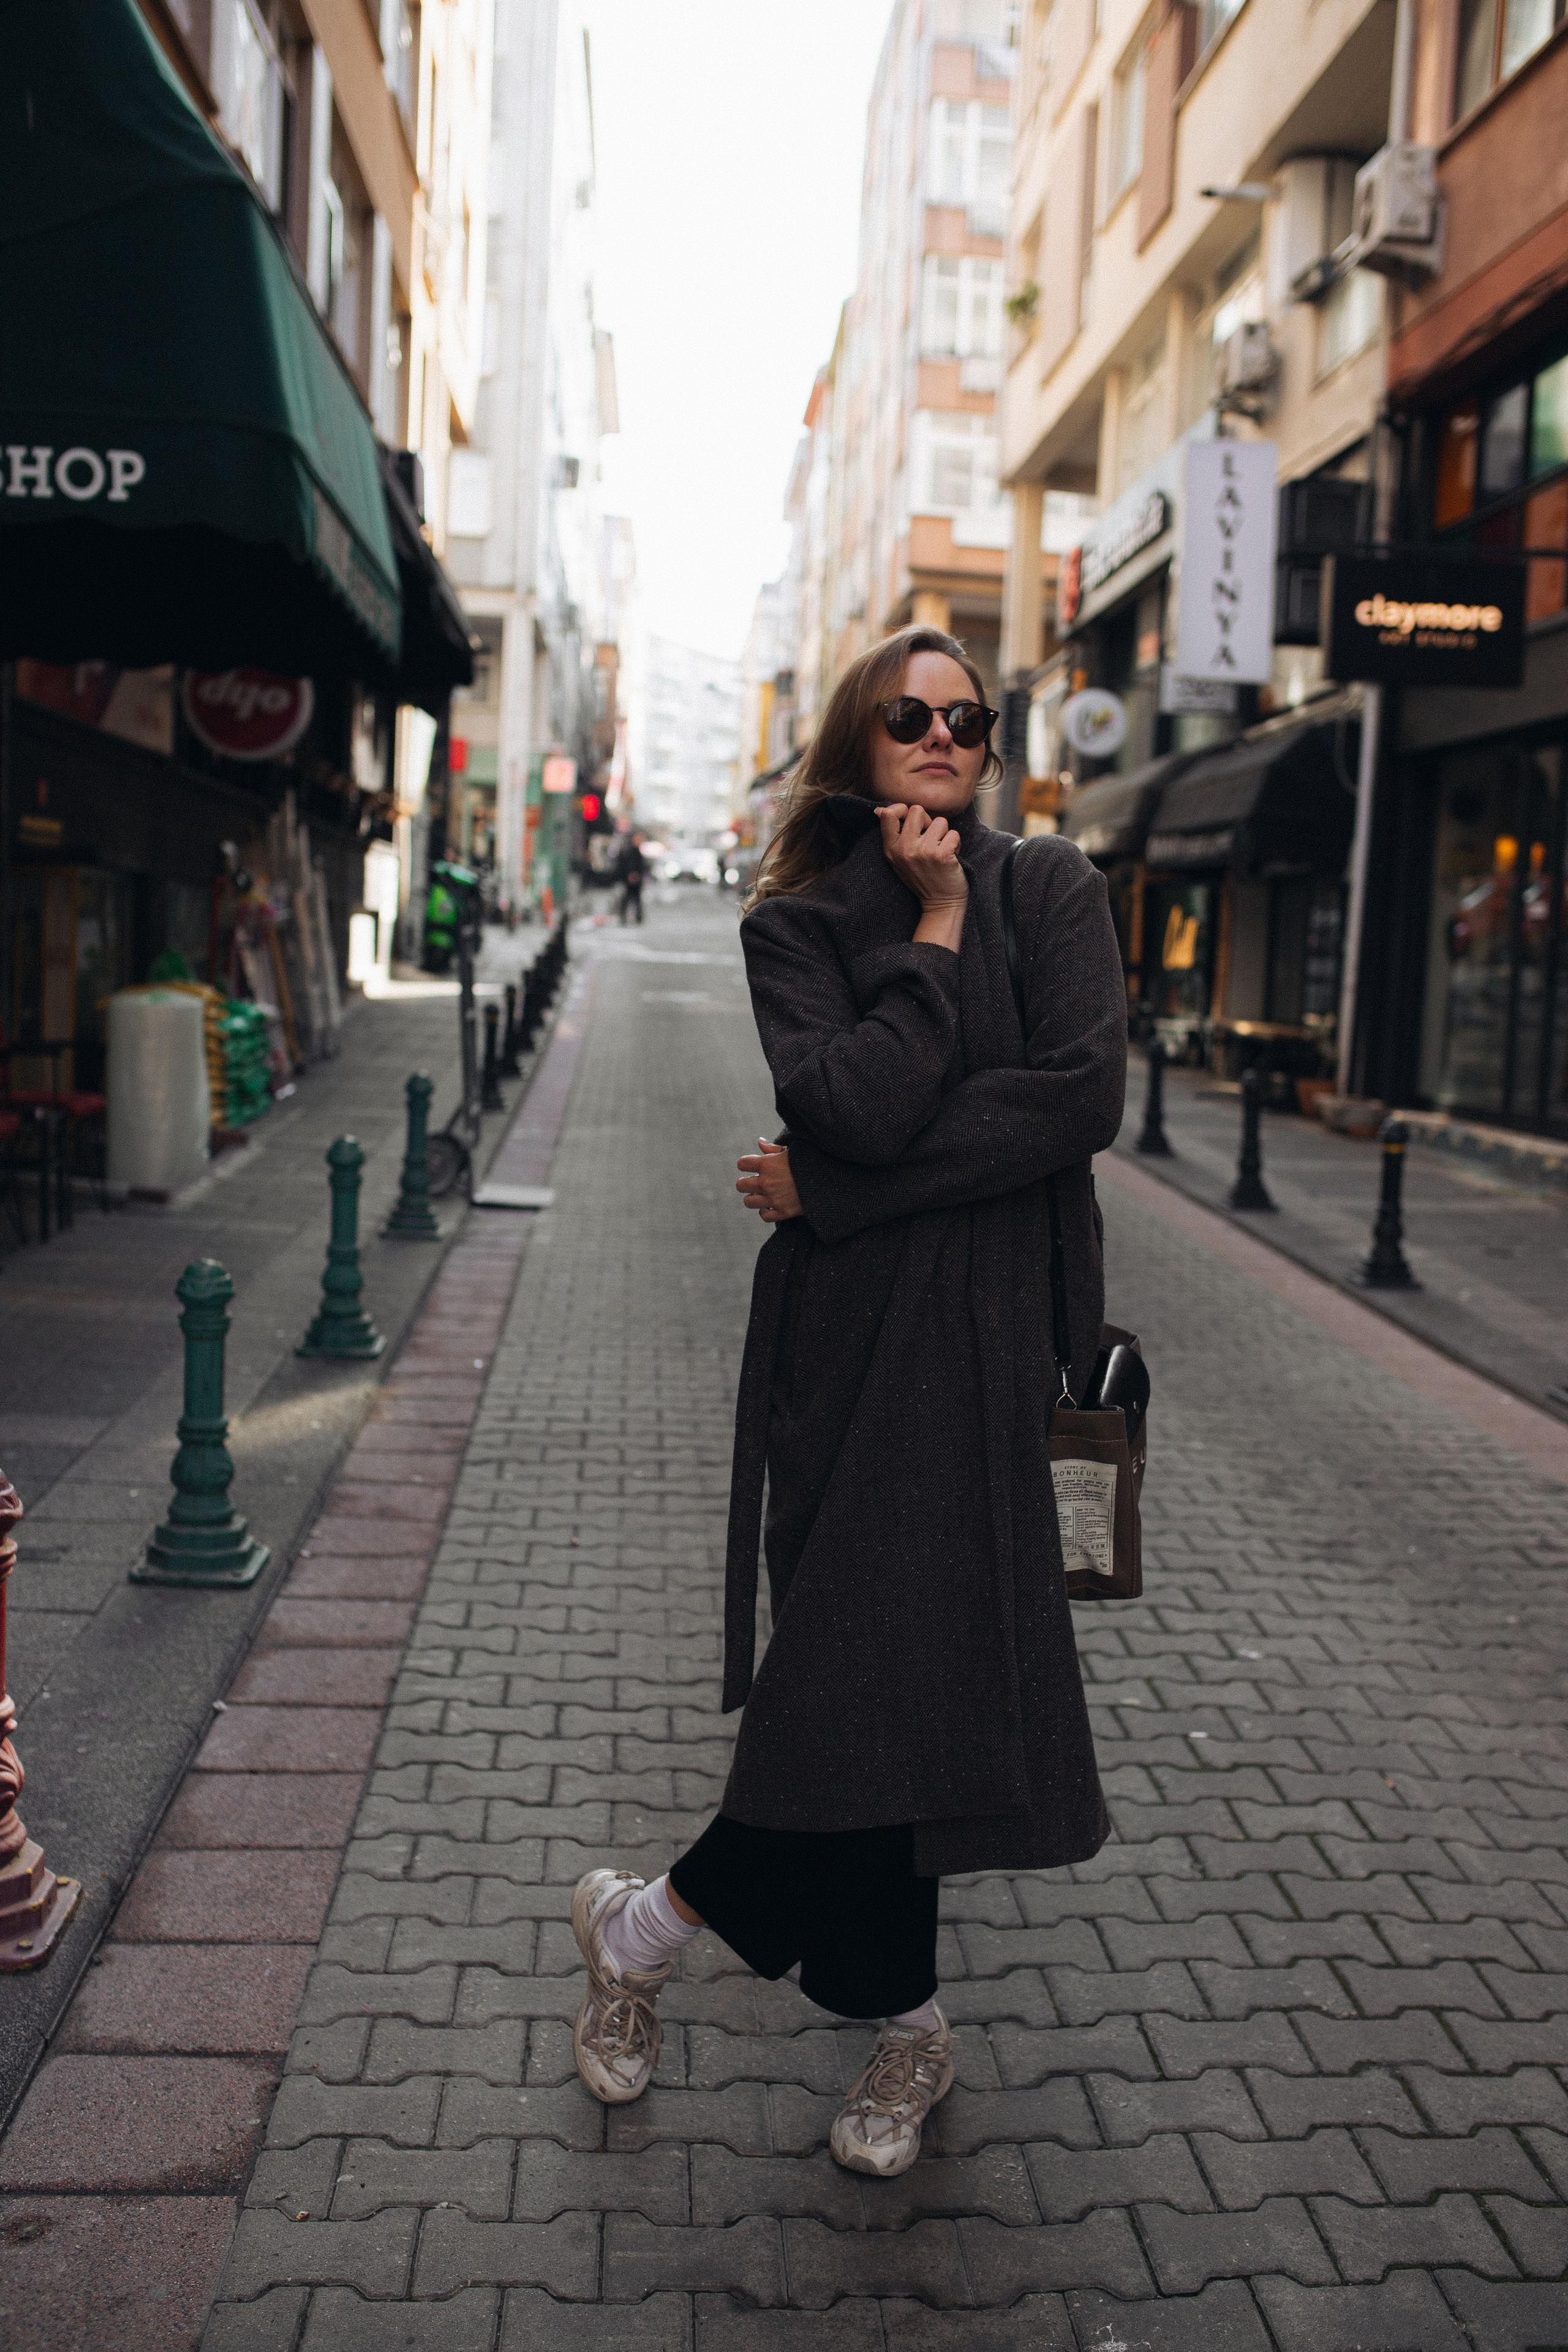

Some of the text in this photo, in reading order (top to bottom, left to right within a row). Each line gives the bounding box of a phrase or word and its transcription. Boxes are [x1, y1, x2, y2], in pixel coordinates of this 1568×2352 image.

[0, 444, 146, 501] HOP
[1210, 452, 1243, 669] LAVINYA
[1355, 592, 1503, 635] claymore
